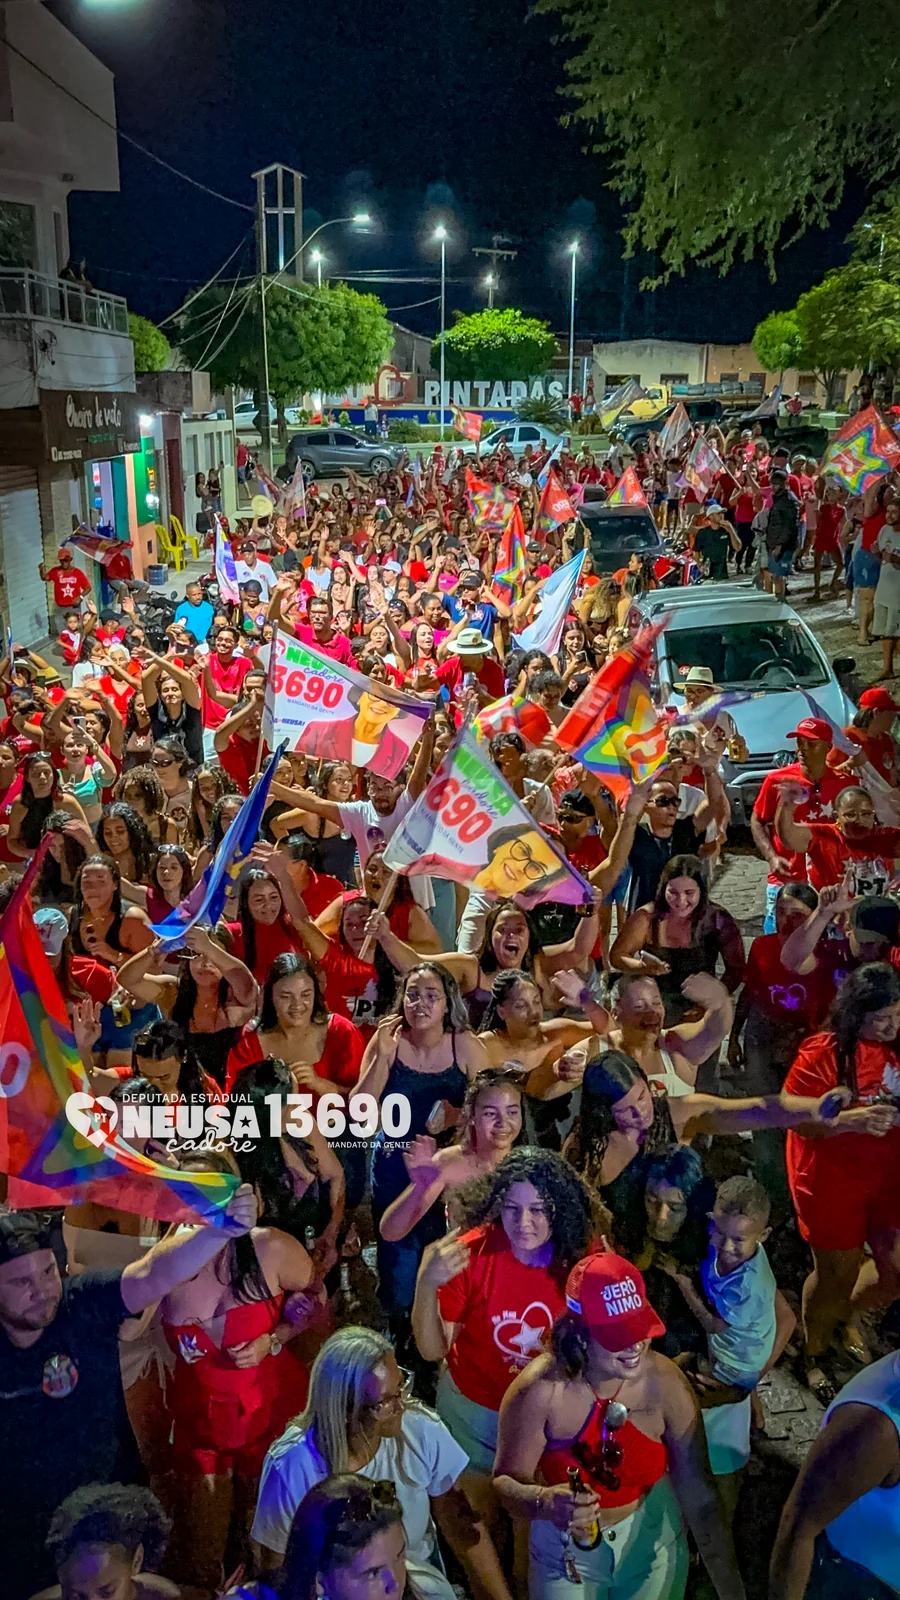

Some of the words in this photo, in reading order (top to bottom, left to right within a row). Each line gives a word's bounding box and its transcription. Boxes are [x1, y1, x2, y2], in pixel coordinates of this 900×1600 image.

[424, 380, 563, 407] PINTADAS
[303, 667, 345, 684] cadore
[426, 777, 493, 844] 690
[857, 877, 886, 897] PT
[600, 1275, 637, 1301] JERÔ
[605, 1294, 642, 1317] NIMO
